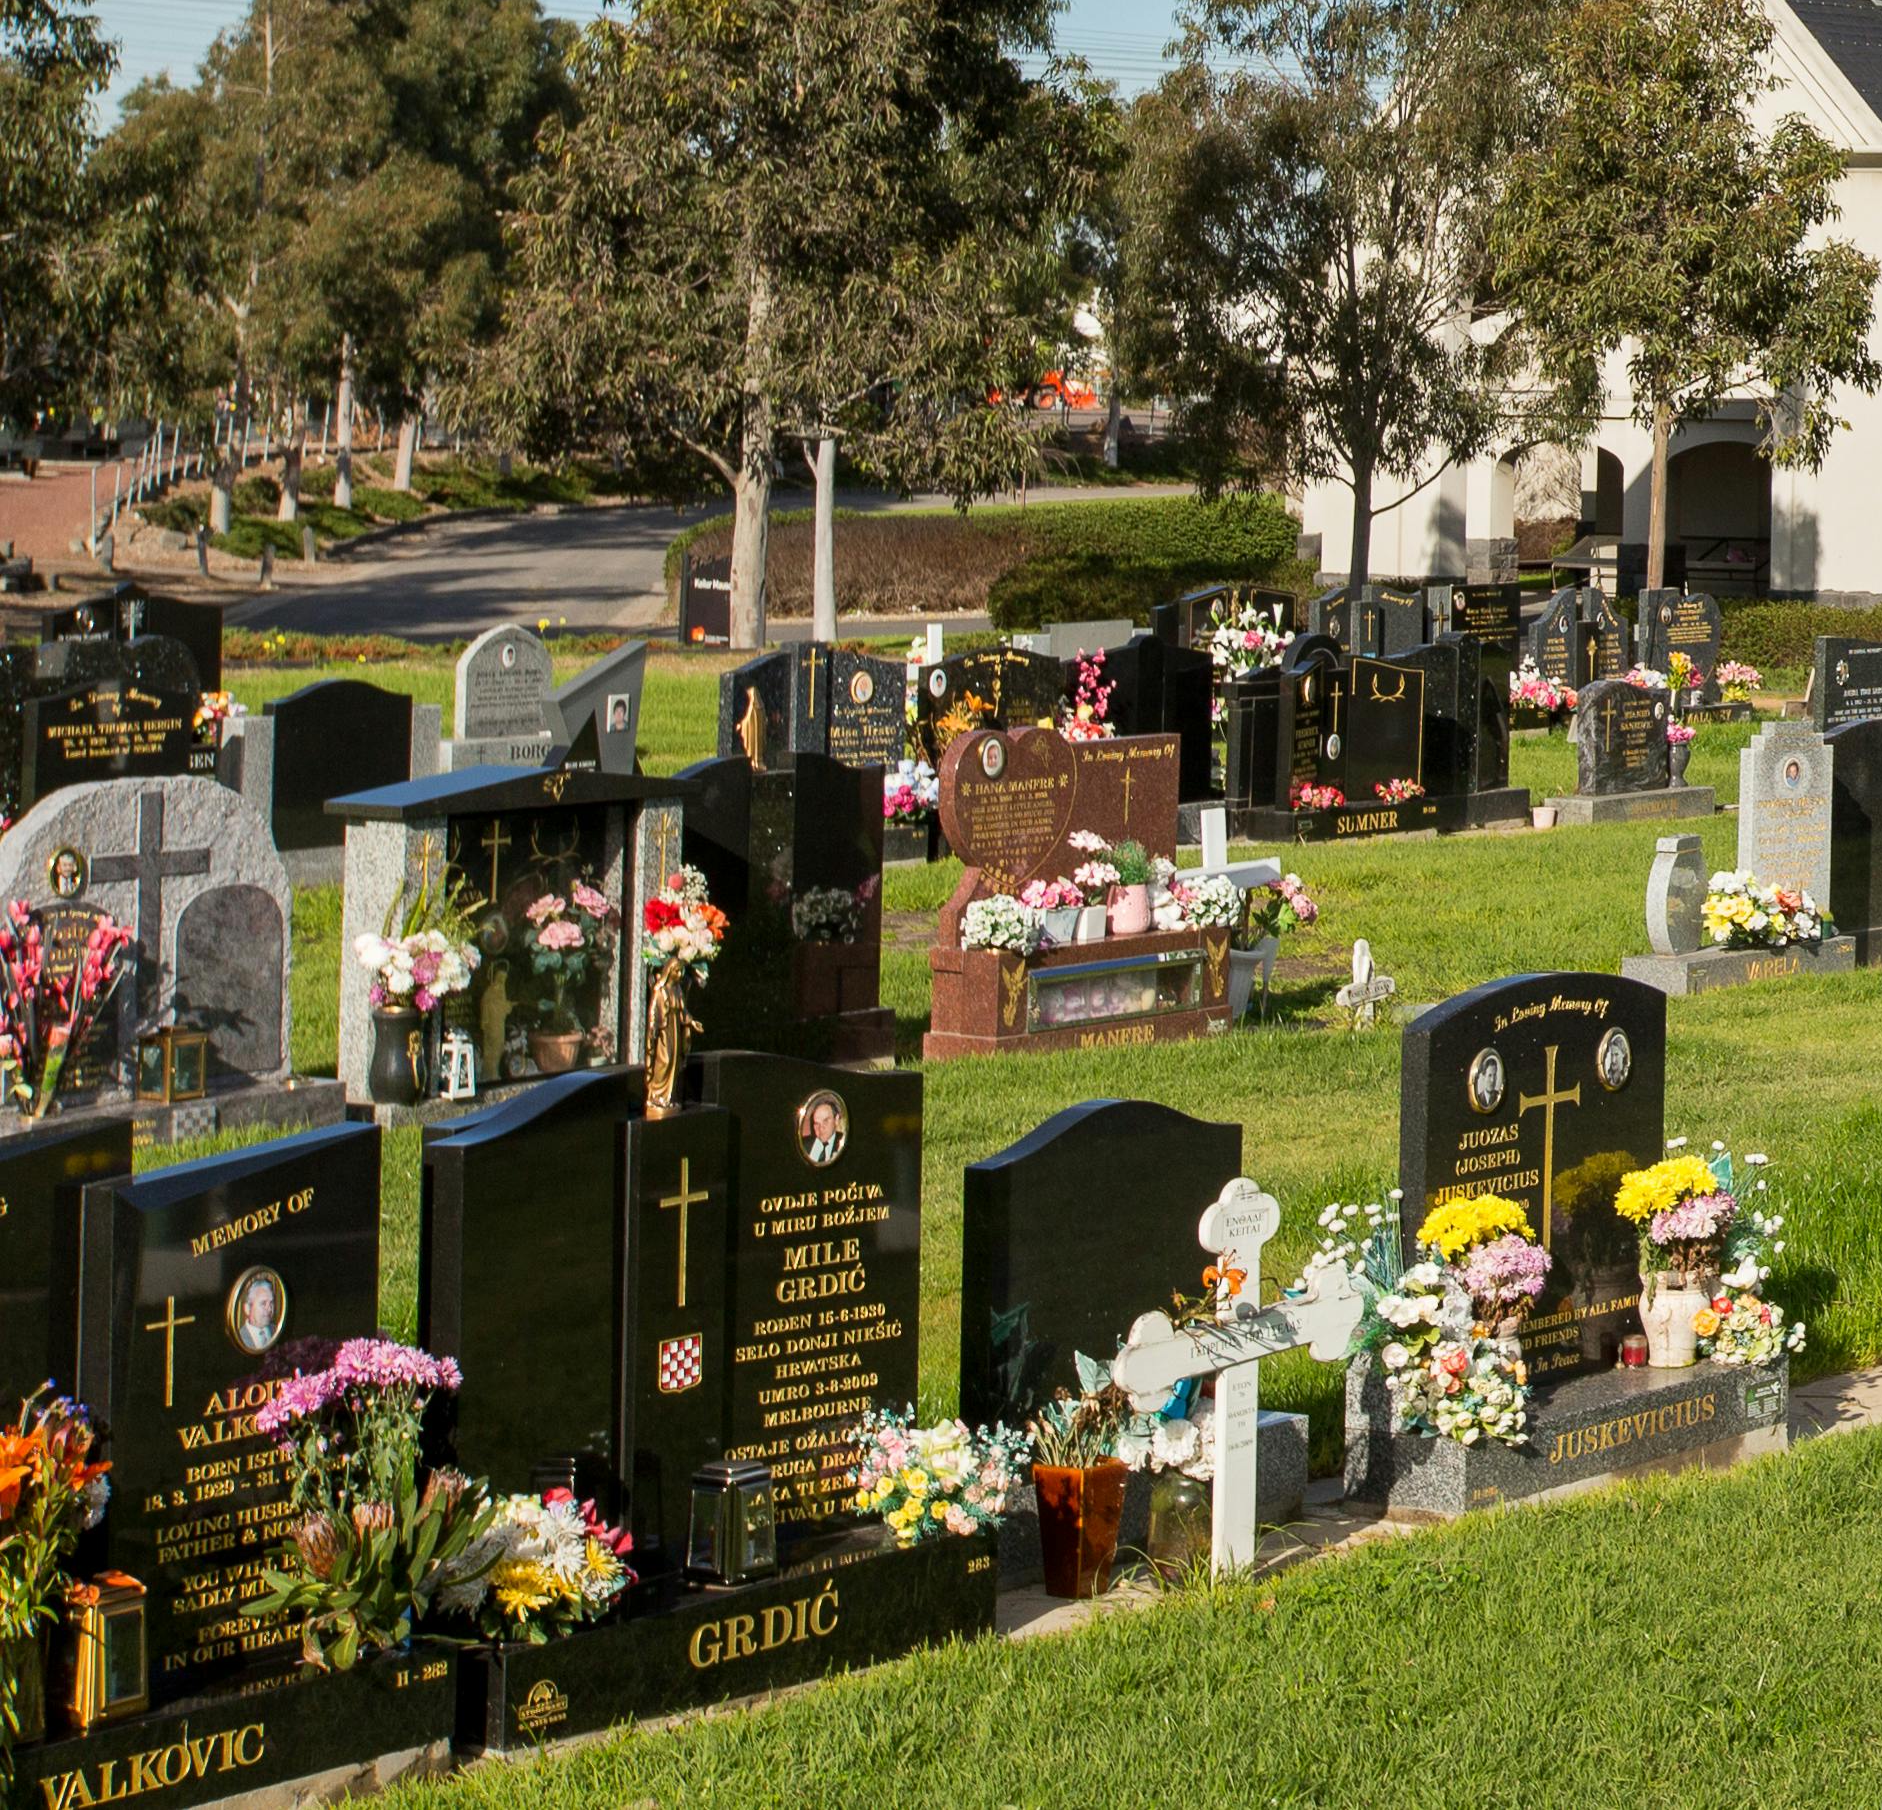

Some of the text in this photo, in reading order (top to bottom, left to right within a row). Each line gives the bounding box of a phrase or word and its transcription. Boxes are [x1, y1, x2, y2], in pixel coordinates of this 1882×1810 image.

[1081, 744, 1175, 764] In Loving Memory Of
[975, 777, 1055, 796] HANA MANFRE
[1337, 810, 1398, 834] SUMNER
[1745, 956, 1799, 980] VARELA
[1494, 995, 1609, 1033] In Loving Memory Of
[1081, 1024, 1154, 1048] MANFRE
[1459, 1123, 1519, 1150] JUOZAS
[1456, 1149, 1520, 1177] (JOSEPH)
[760, 1181, 884, 1214] OVDJE POČIVA
[1434, 1169, 1539, 1205] JUSKEVICIUS
[190, 1187, 315, 1258] MEMORY OF
[754, 1205, 891, 1238] U MIRU BOŽJEM
[783, 1237, 860, 1271] MILE
[776, 1262, 866, 1304] GRDIĆ
[818, 1302, 886, 1326] 15-6-1930
[1518, 1311, 1573, 1335] EMBERED
[1574, 1307, 1587, 1320] BY
[1589, 1302, 1610, 1317] ALL
[735, 1318, 902, 1363] SELO DONJI NIKŠIĆ
[1521, 1325, 1580, 1351] ND FRIENDS
[775, 1352, 862, 1380] HRVATSKA
[1537, 1352, 1580, 1374] In Peace
[758, 1372, 879, 1406] UMRO 3-8-2009
[763, 1395, 872, 1428] MELBOURNE
[724, 1427, 860, 1462] OSTAJE OŽALO
[1549, 1393, 1716, 1465] JUSKEVICIUS
[186, 1447, 295, 1484] BORN ISTR
[771, 1458, 816, 1479] RUGA
[144, 1473, 280, 1513] 18. 3. 1929 31.
[797, 1480, 815, 1497] TI
[156, 1500, 301, 1545] LOVING HUSBA
[823, 1501, 835, 1515] U
[157, 1534, 236, 1565] FATHER
[243, 1528, 257, 1545] &
[182, 1571, 220, 1594] YOU
[226, 1558, 277, 1582] WILL
[173, 1588, 233, 1614] SADLY
[198, 1609, 289, 1645] FOREVER
[689, 1577, 839, 1670] GRDIĆ
[165, 1652, 188, 1671] IN
[193, 1641, 236, 1663] OUR
[423, 1660, 448, 1681] 282
[39, 1721, 267, 1810] VALKOVIC
